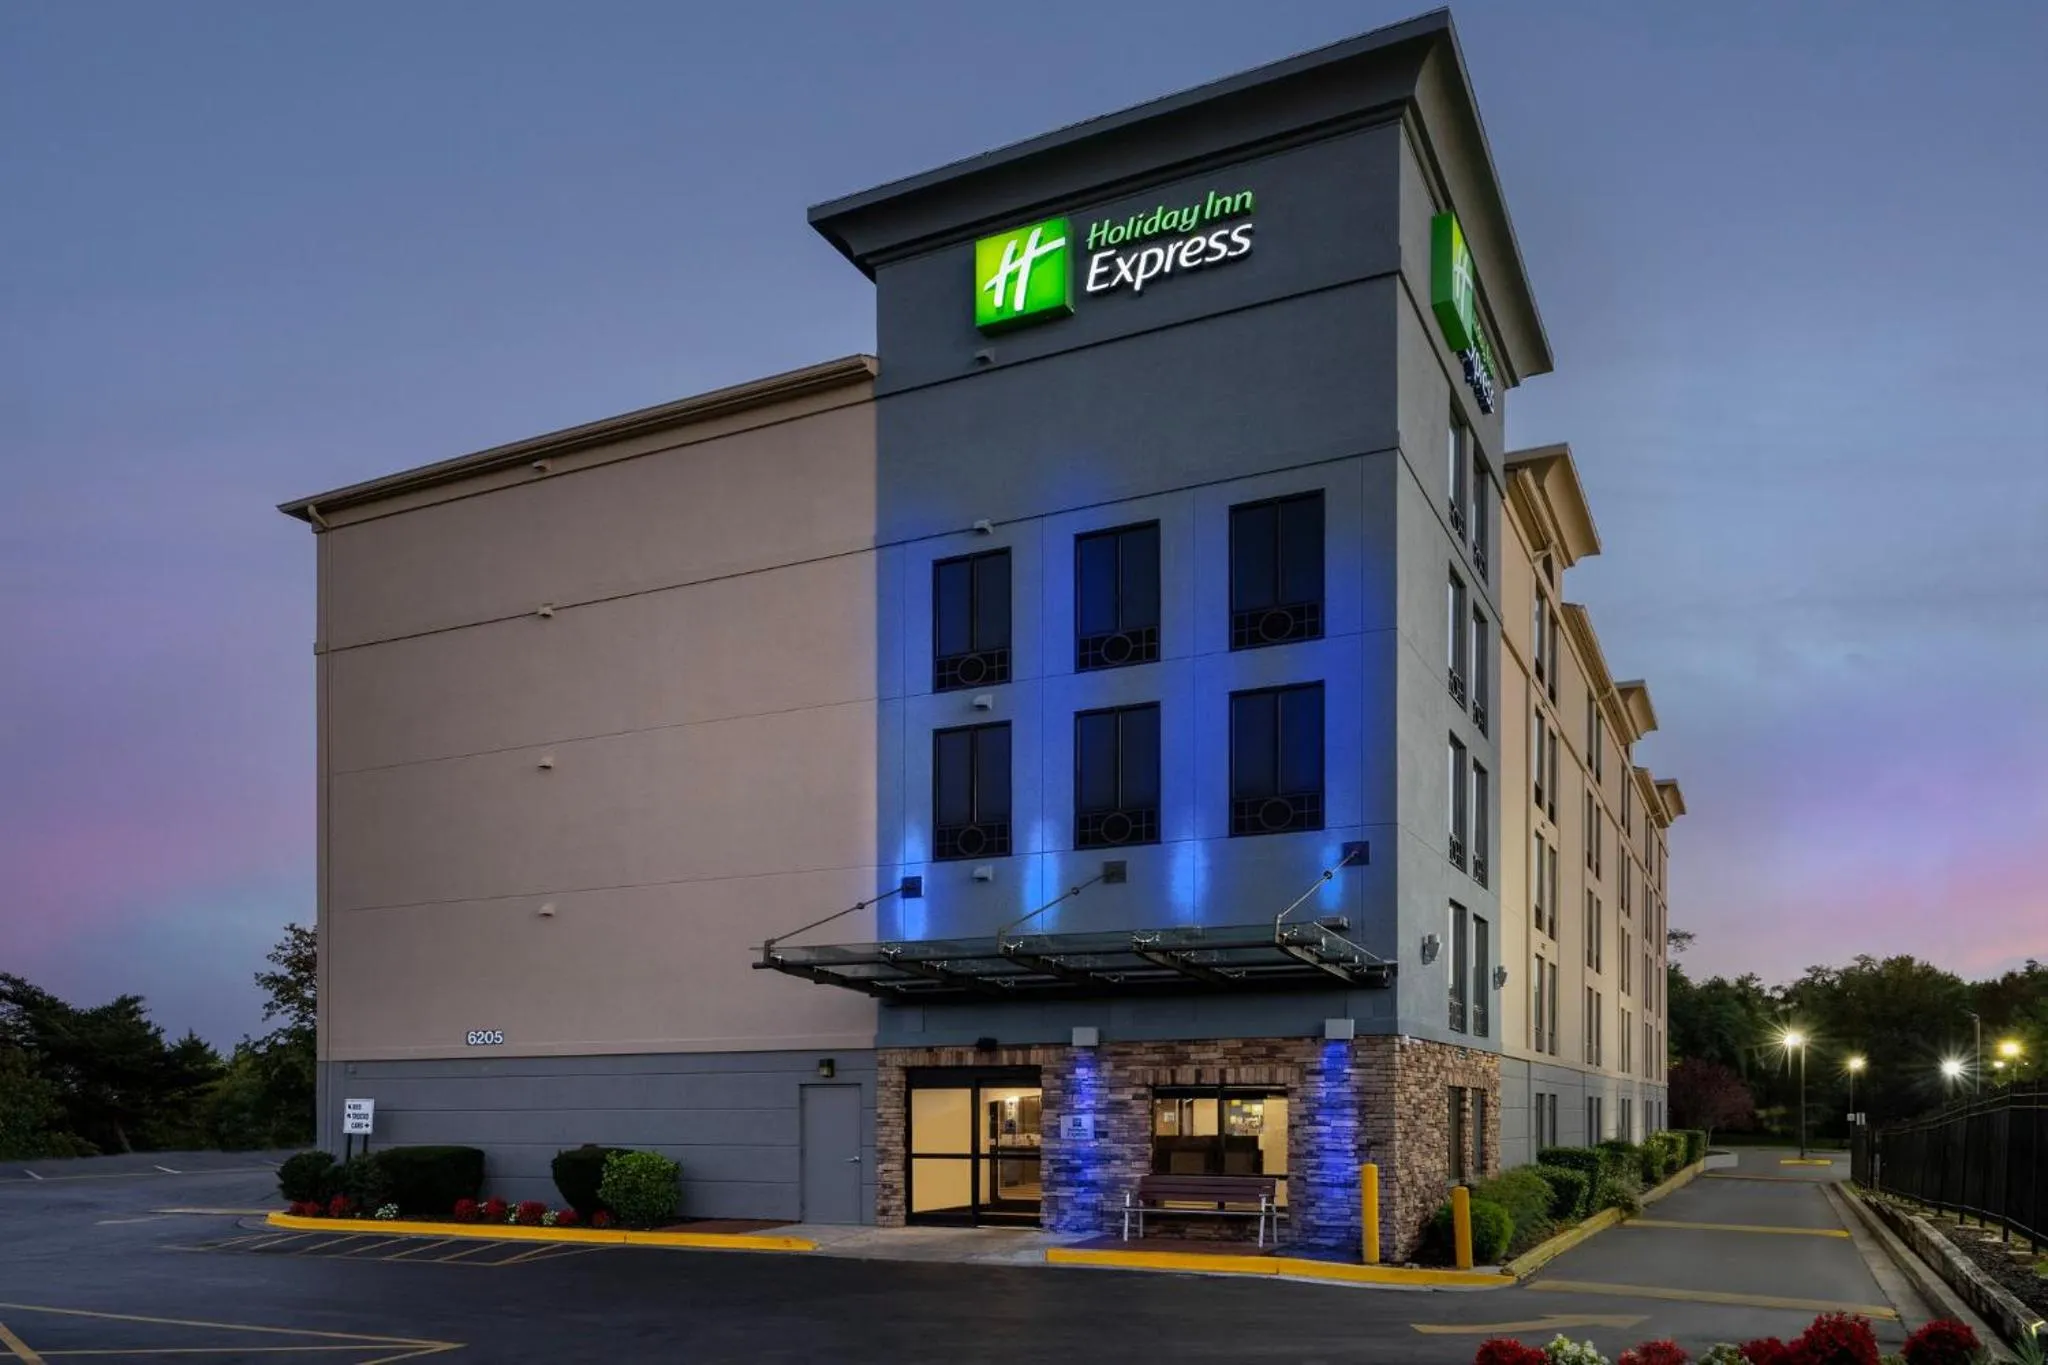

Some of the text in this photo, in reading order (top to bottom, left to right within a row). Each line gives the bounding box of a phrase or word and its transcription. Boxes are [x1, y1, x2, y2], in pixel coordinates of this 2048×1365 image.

[1087, 189, 1253, 250] Holiday Inn
[1086, 223, 1253, 292] Express
[467, 1030, 504, 1045] 6205
